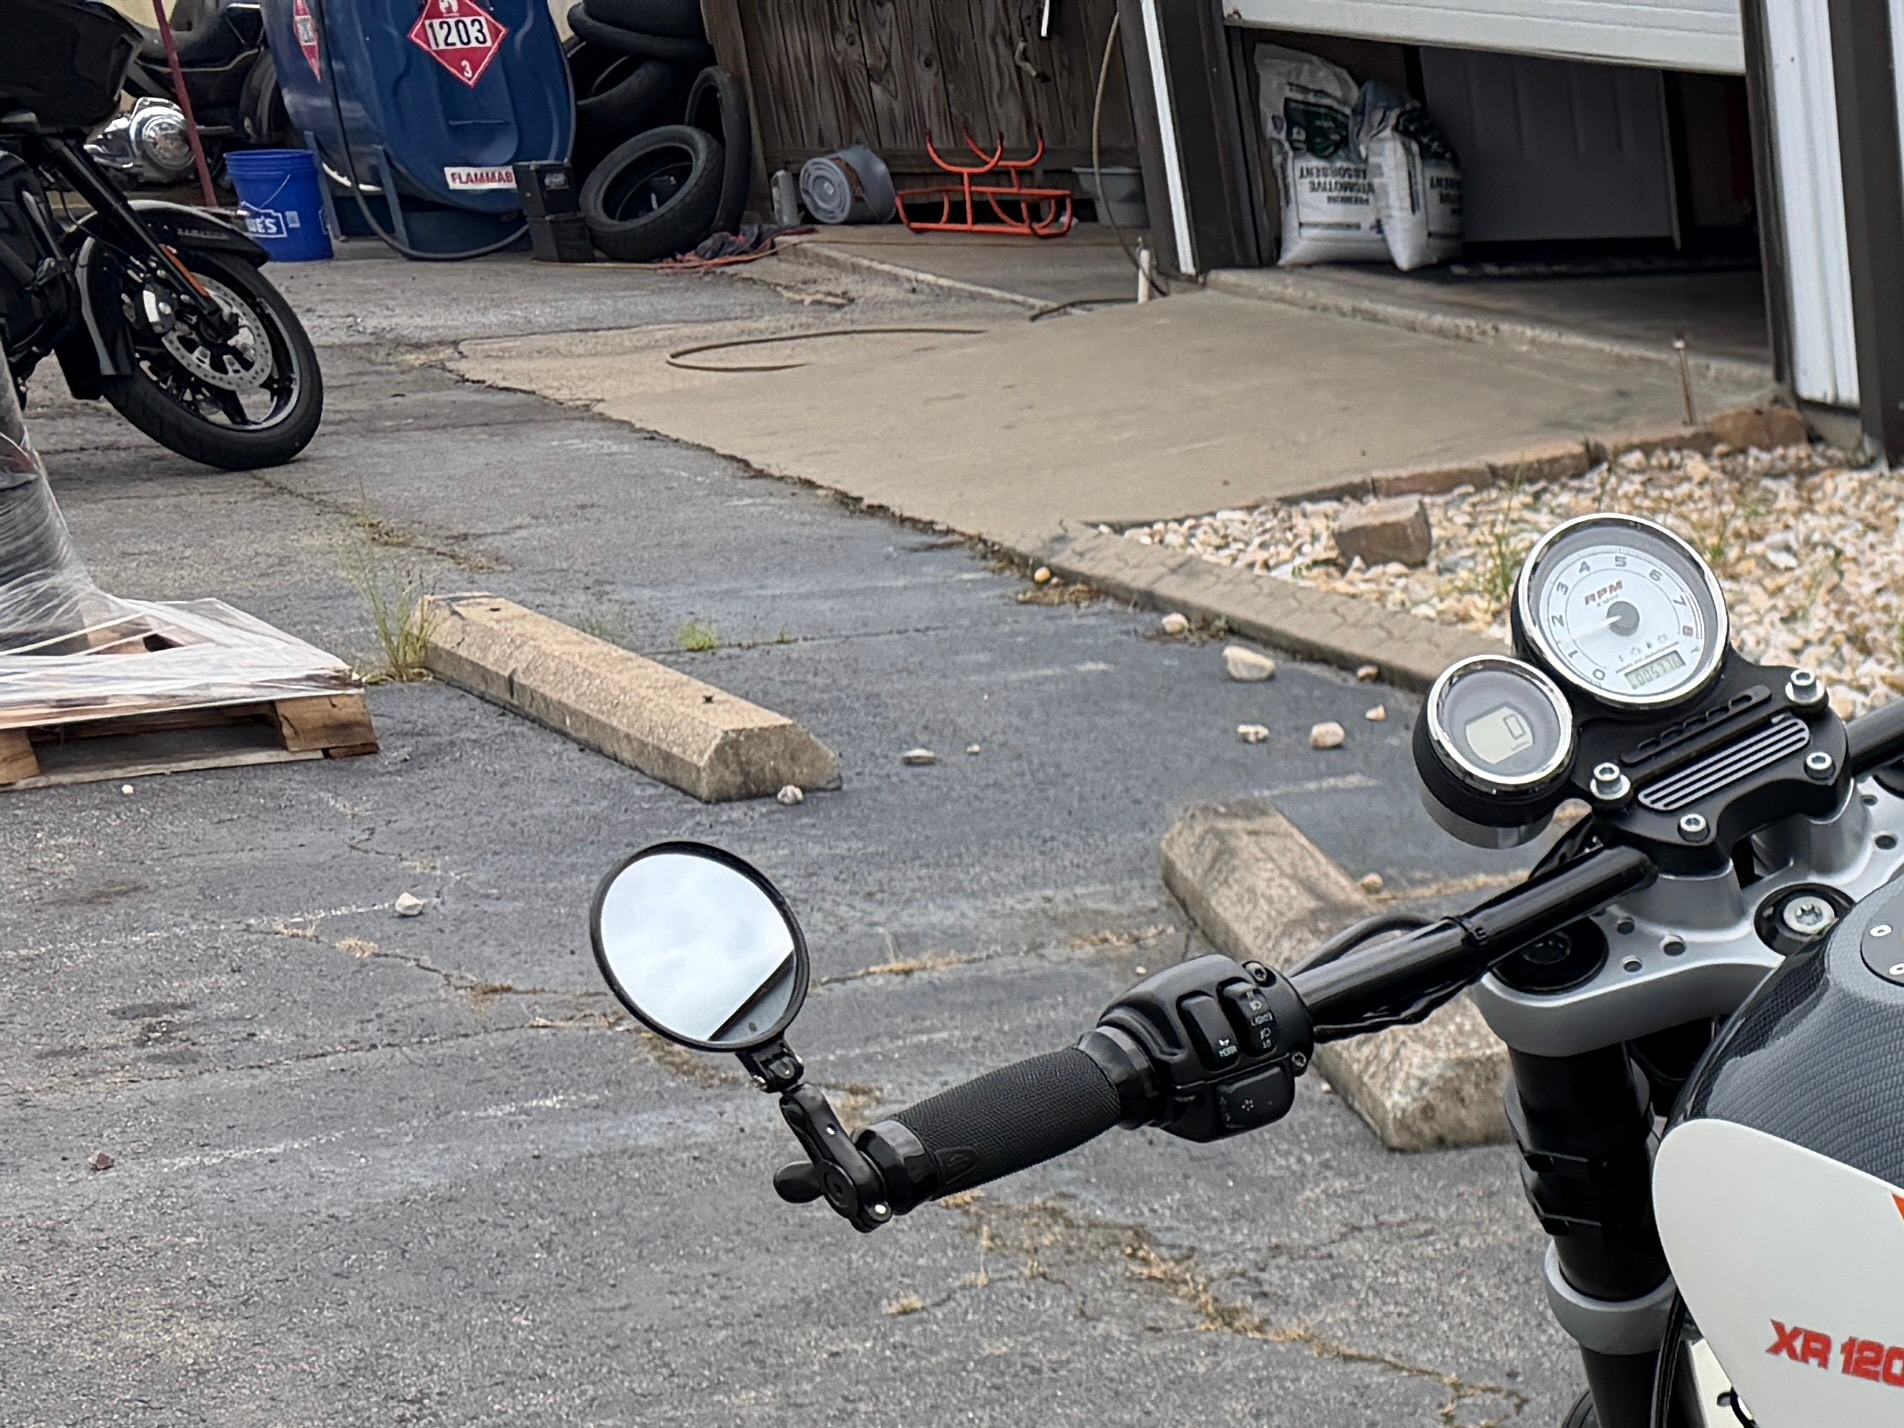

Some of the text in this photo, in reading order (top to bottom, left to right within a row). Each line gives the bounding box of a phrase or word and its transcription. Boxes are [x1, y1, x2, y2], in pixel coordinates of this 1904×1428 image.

[428, 18, 488, 49] 1203
[460, 60, 472, 78] 3
[451, 171, 513, 184] FLAMMAB
[1578, 560, 1591, 573] 4
[1614, 556, 1627, 567] 5
[1649, 569, 1663, 582] 6
[1556, 581, 1569, 595] 3
[1584, 580, 1623, 605] RPM
[1673, 594, 1687, 608] 7
[1551, 614, 1565, 627] 2
[1592, 668, 1606, 681] 0
[1765, 1318, 1832, 1370] XR
